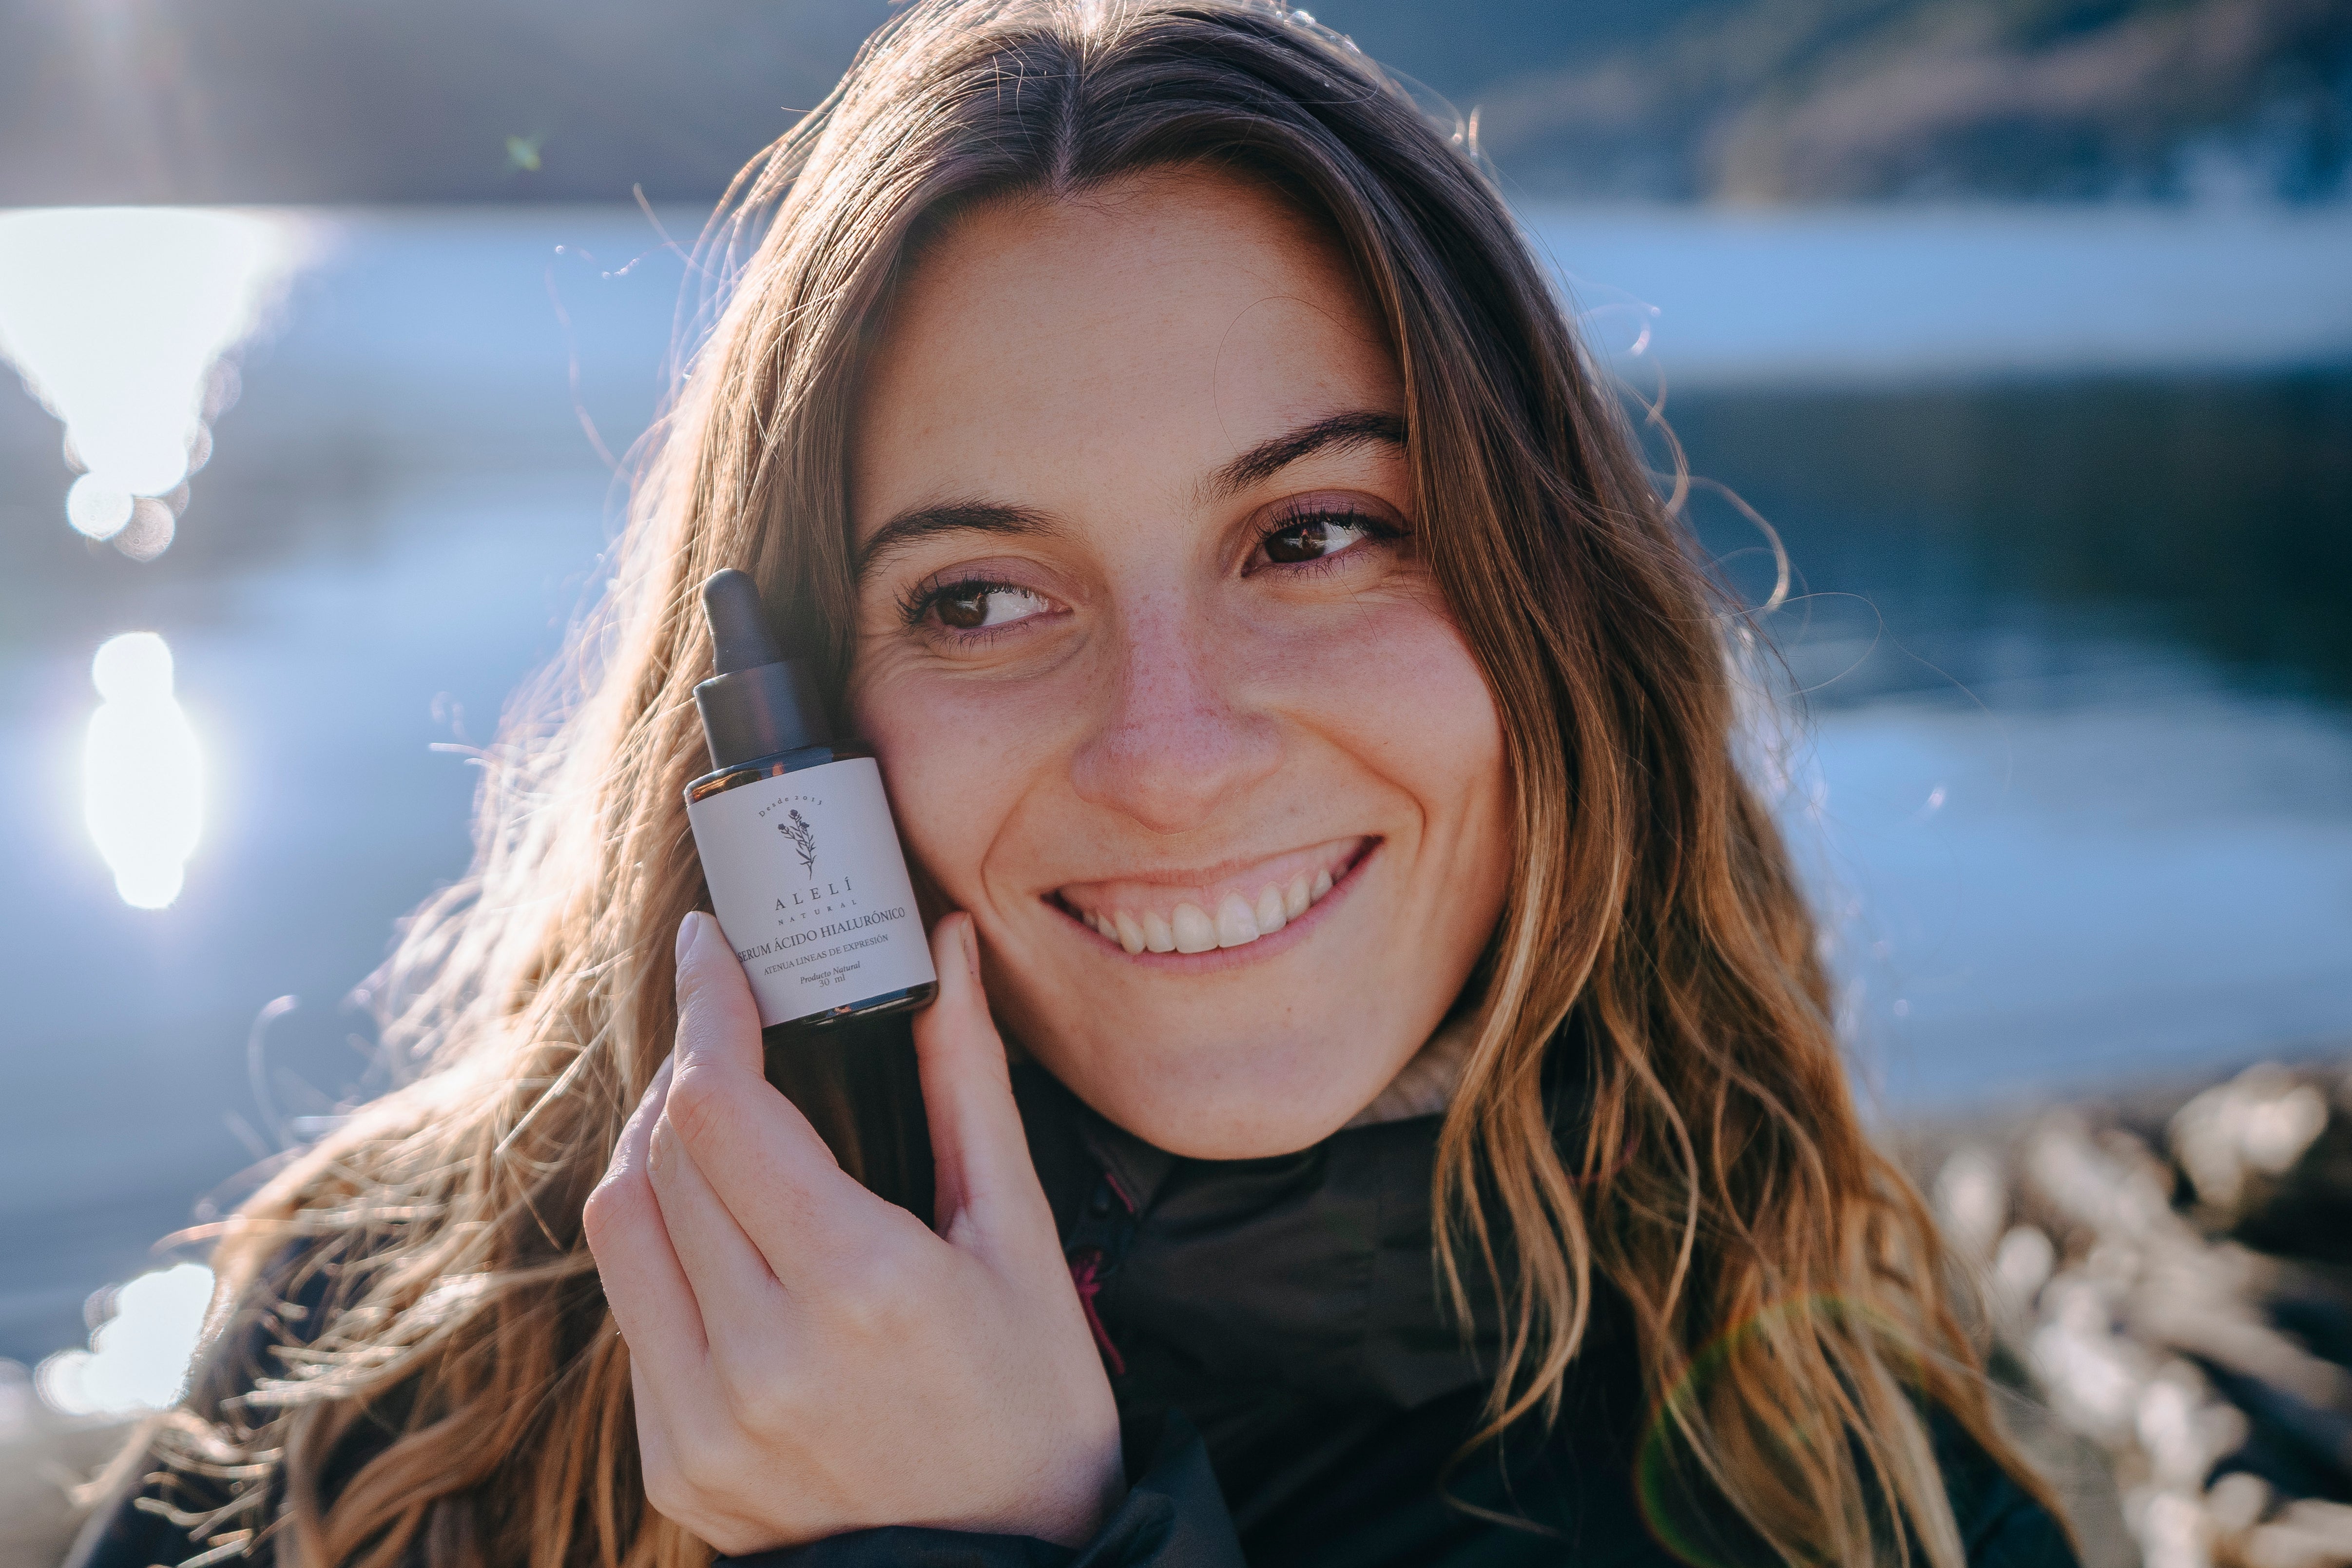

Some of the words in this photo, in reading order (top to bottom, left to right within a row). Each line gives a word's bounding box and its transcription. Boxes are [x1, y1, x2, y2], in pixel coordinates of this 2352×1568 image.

[759, 797, 789, 817] Desde
[775, 876, 851, 910] ALELÍ
[778, 899, 856, 926] NATURAL
[737, 943, 771, 963] SERUM
[774, 930, 817, 952] ÁCIDO
[820, 907, 905, 938] HIALURÓNICO
[764, 961, 795, 975] ATENUA
[795, 951, 827, 966] LINEAS
[829, 948, 842, 957] DE
[843, 933, 888, 952] EXPRESIÓN
[800, 971, 831, 984] Producto
[832, 961, 861, 975] Natural
[819, 978, 830, 987] 30
[834, 973, 846, 983] ml
